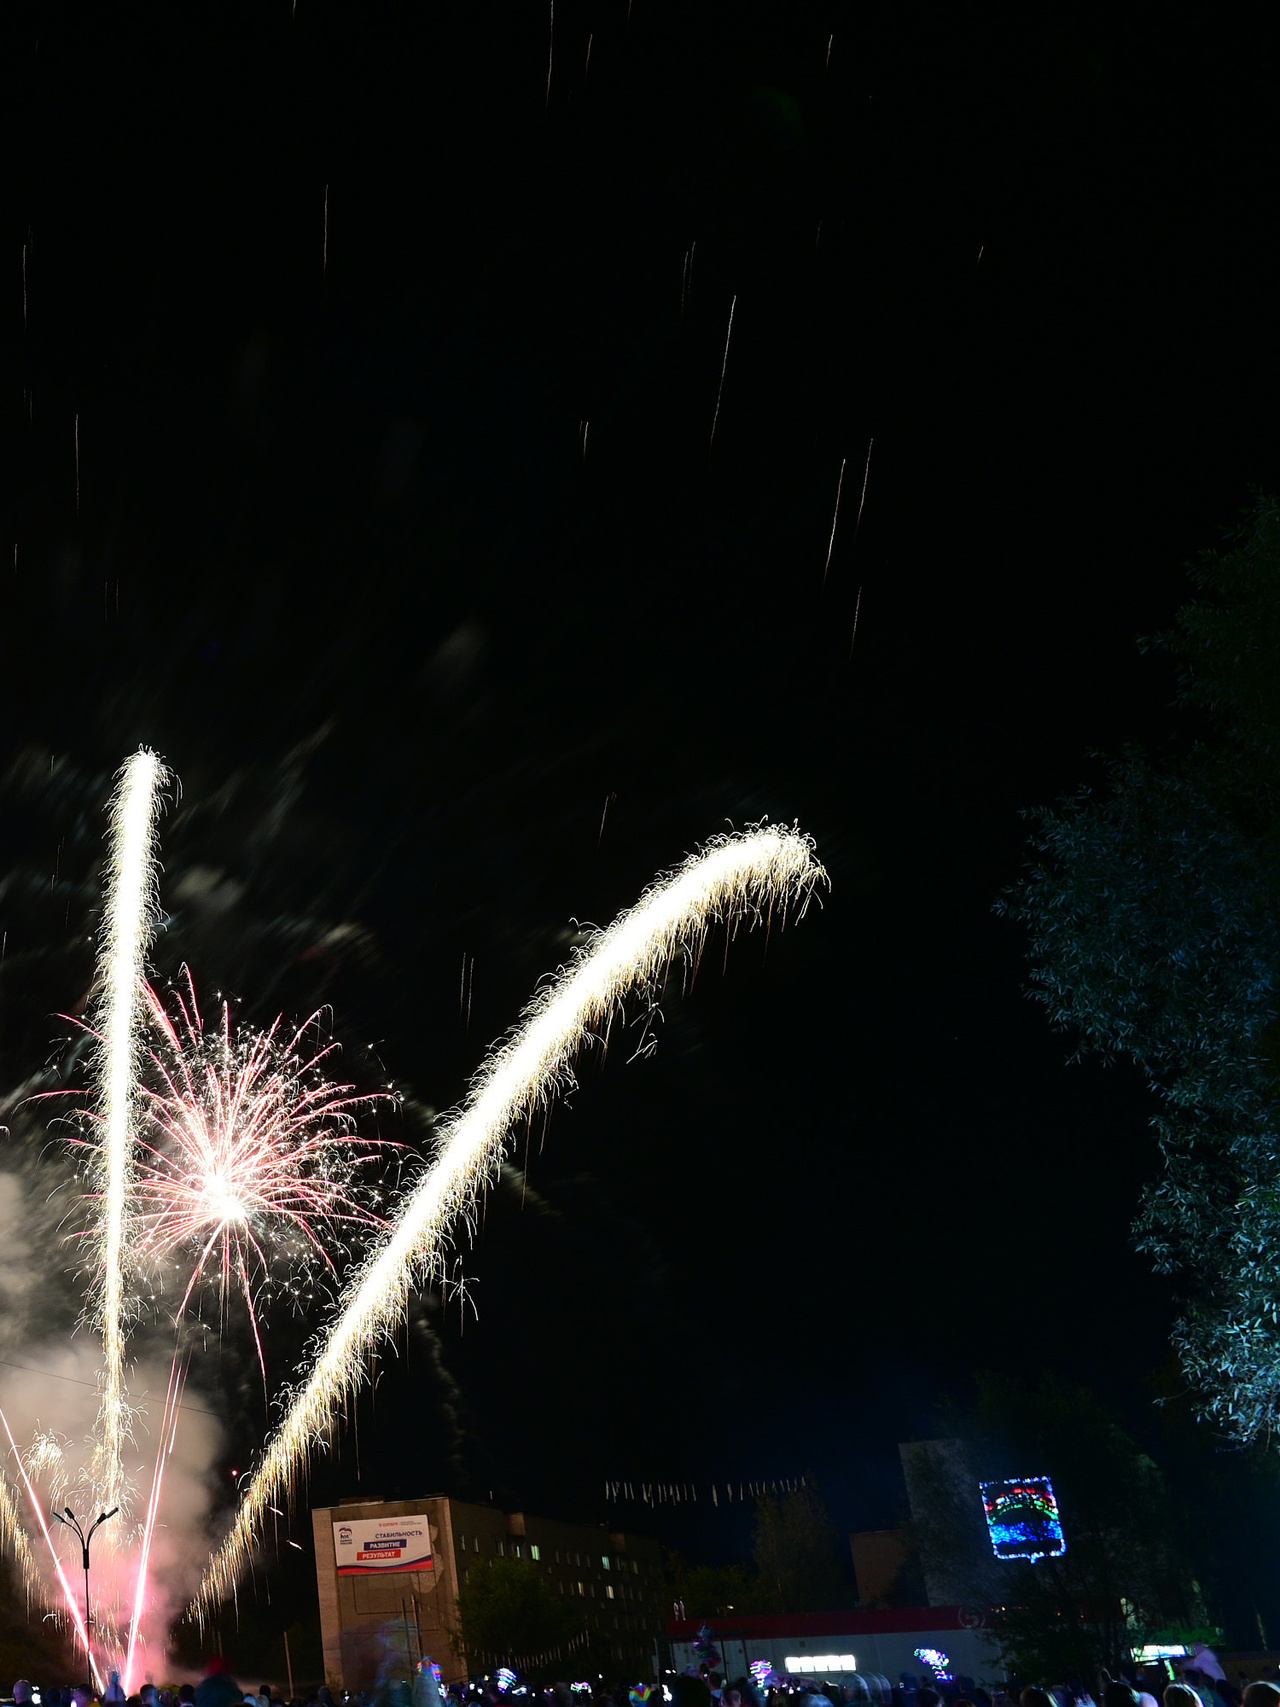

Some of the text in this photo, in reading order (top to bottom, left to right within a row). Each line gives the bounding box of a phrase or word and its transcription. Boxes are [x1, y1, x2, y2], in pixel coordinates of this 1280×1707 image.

[375, 1530, 423, 1539] СТАБИЛЬНОСТЬ
[369, 1541, 401, 1549] РАЗВИТИЕ
[362, 1551, 396, 1559] РЕЗУЛЬТАТ
